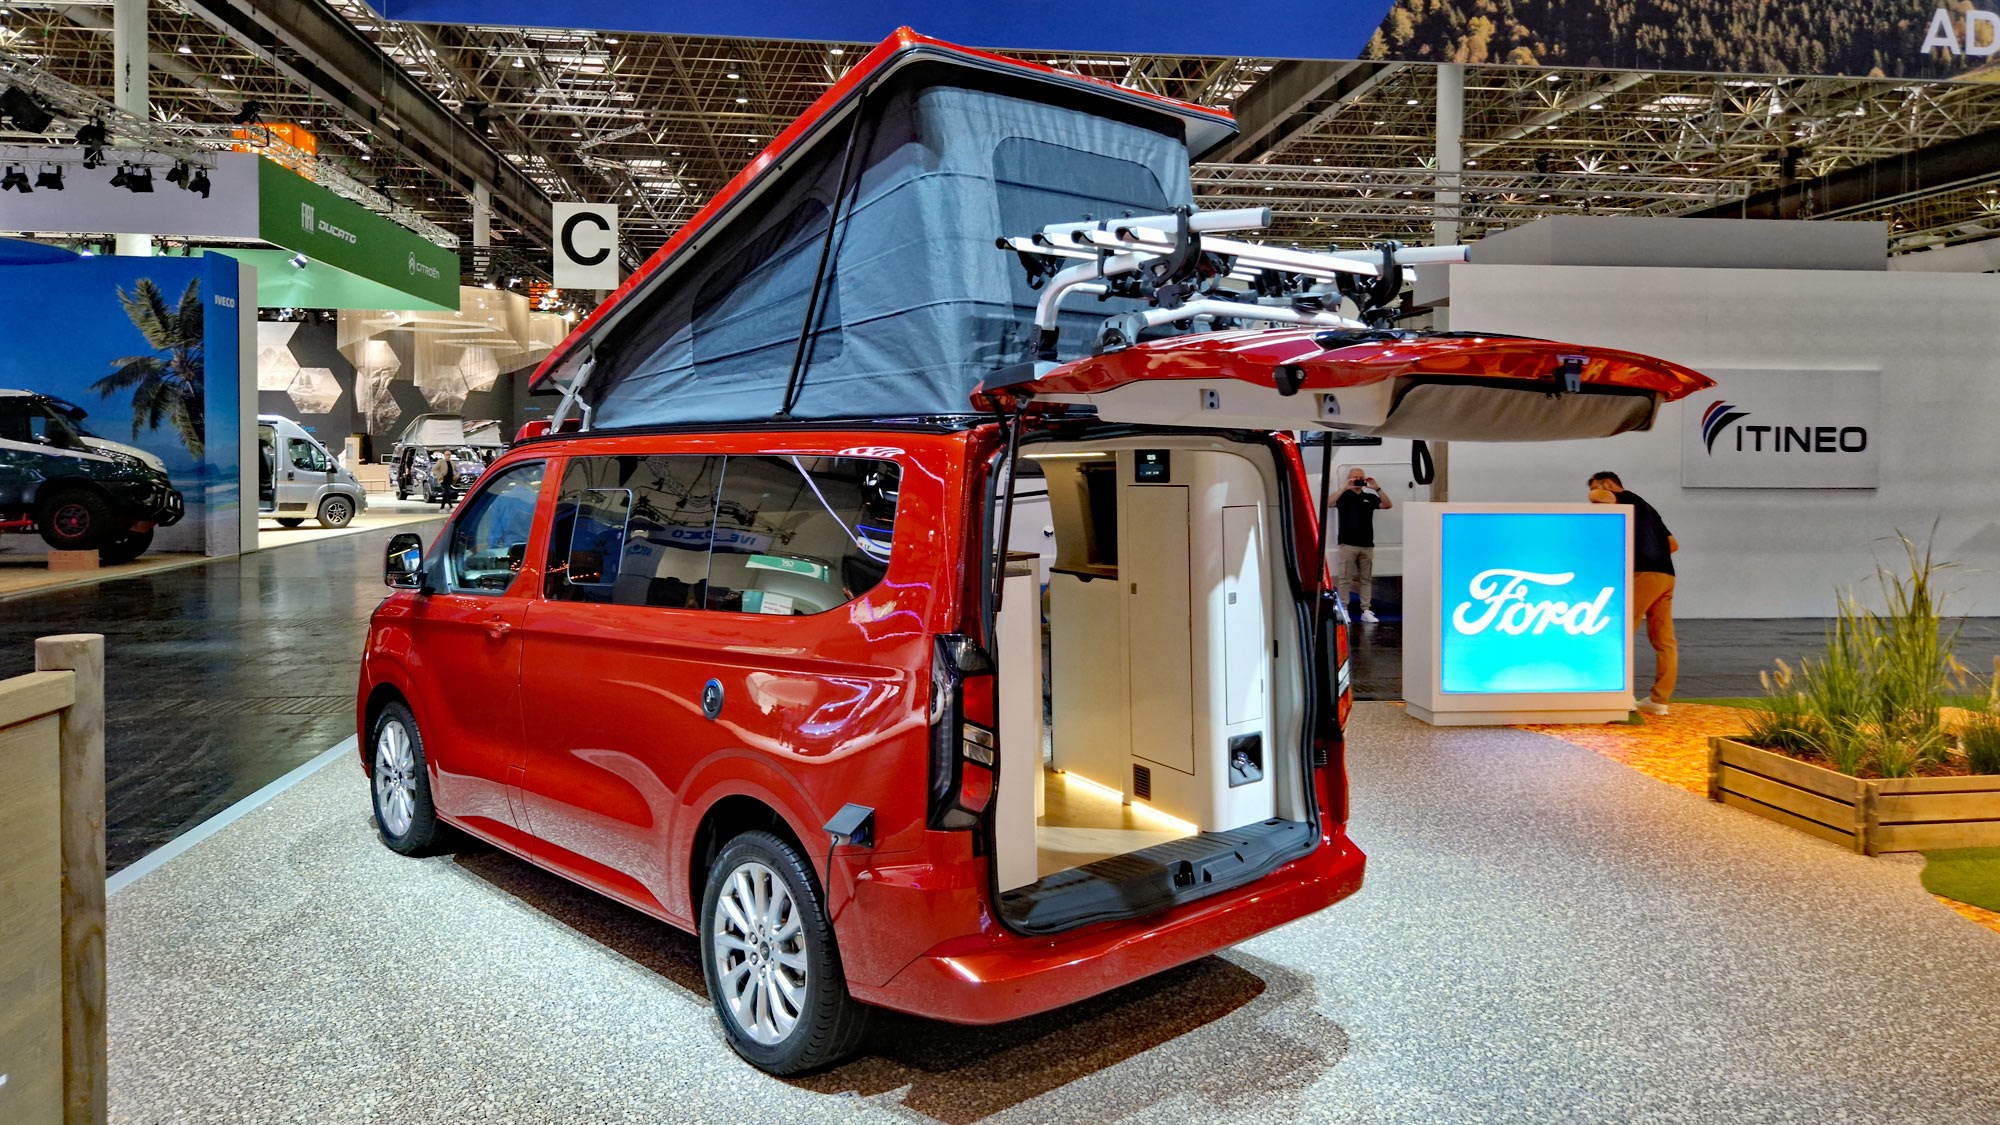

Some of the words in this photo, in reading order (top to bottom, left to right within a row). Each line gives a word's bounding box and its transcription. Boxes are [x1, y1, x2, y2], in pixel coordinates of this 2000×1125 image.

[1920, 8, 2000, 56] AD
[318, 219, 357, 244] DUCATO
[561, 211, 611, 267] C
[214, 294, 235, 308] IVECO
[1736, 425, 1867, 452] ITINEO
[1452, 568, 1615, 636] Ford
